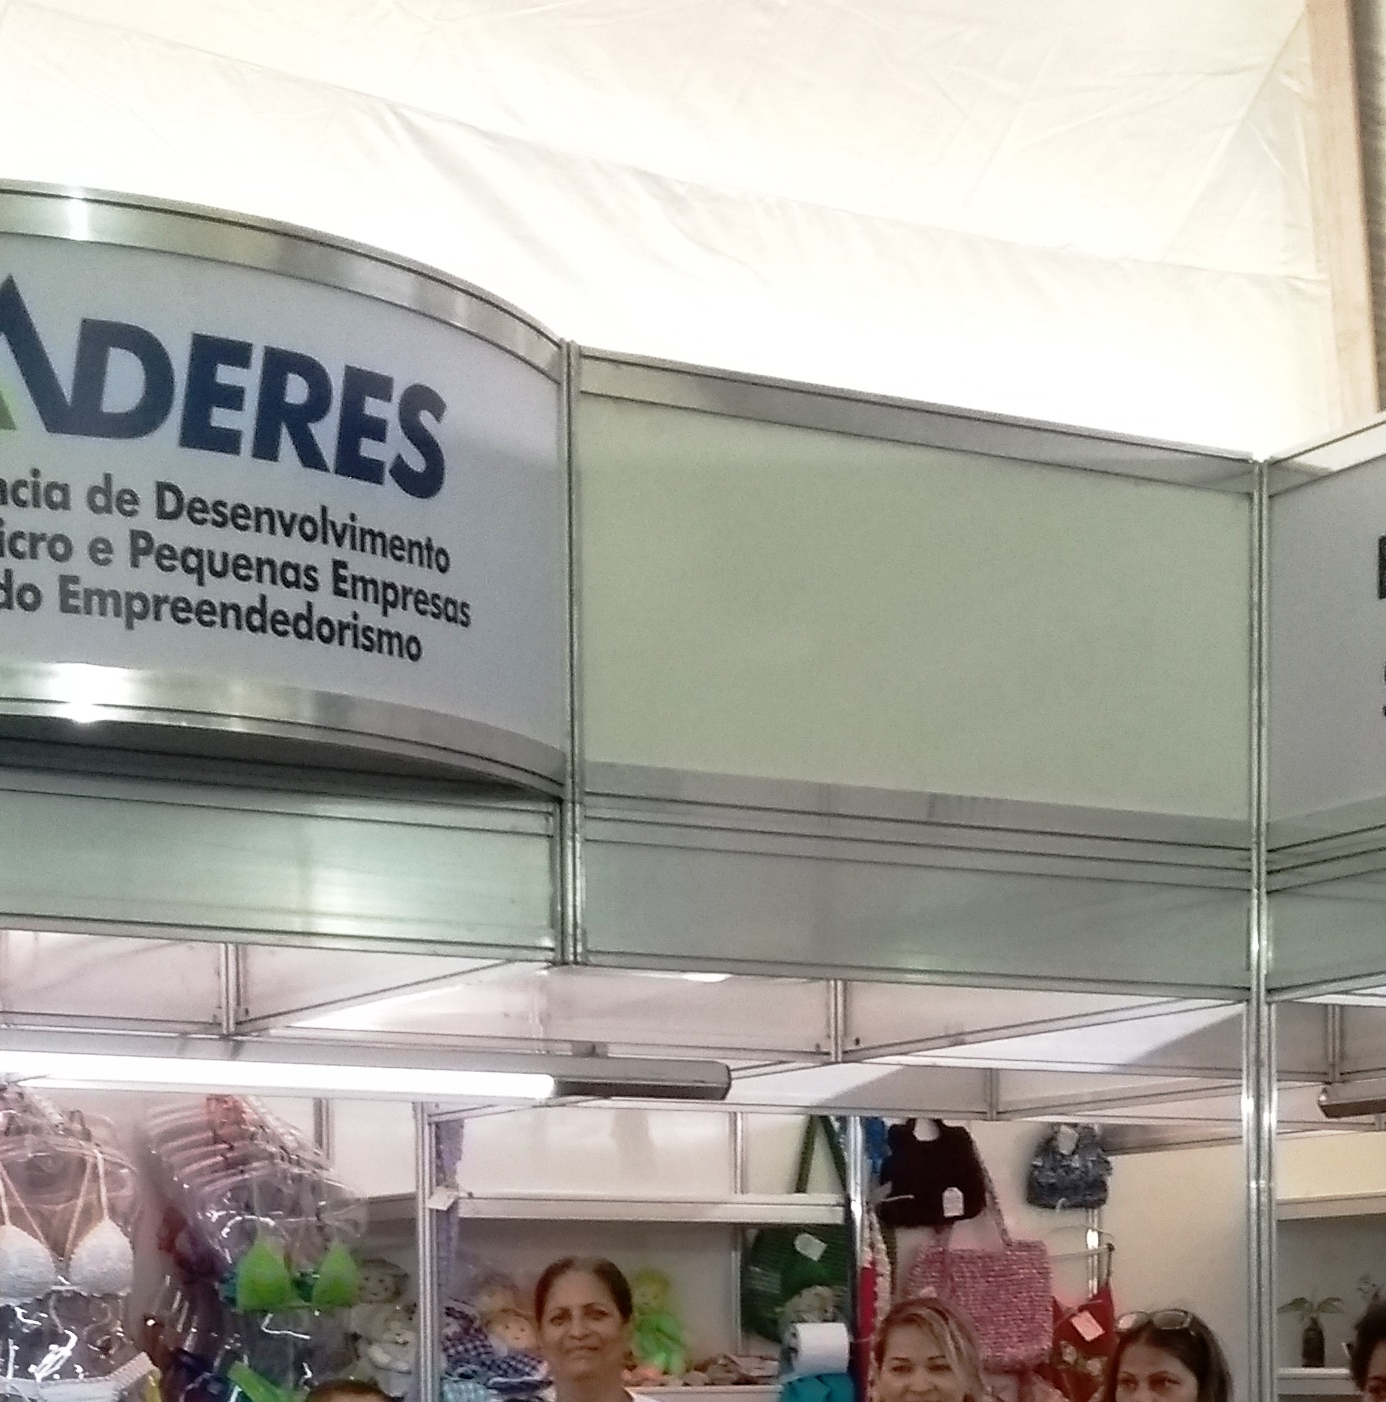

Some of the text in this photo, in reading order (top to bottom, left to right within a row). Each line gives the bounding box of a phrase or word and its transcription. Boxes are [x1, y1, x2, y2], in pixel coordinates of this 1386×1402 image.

[87, 473, 139, 517] de
[155, 480, 450, 574] Desenvolvimento
[59, 575, 422, 662] Empreendedorismo
[88, 536, 113, 566] e
[129, 529, 319, 591] Pequenas
[332, 558, 471, 628] Empresas
